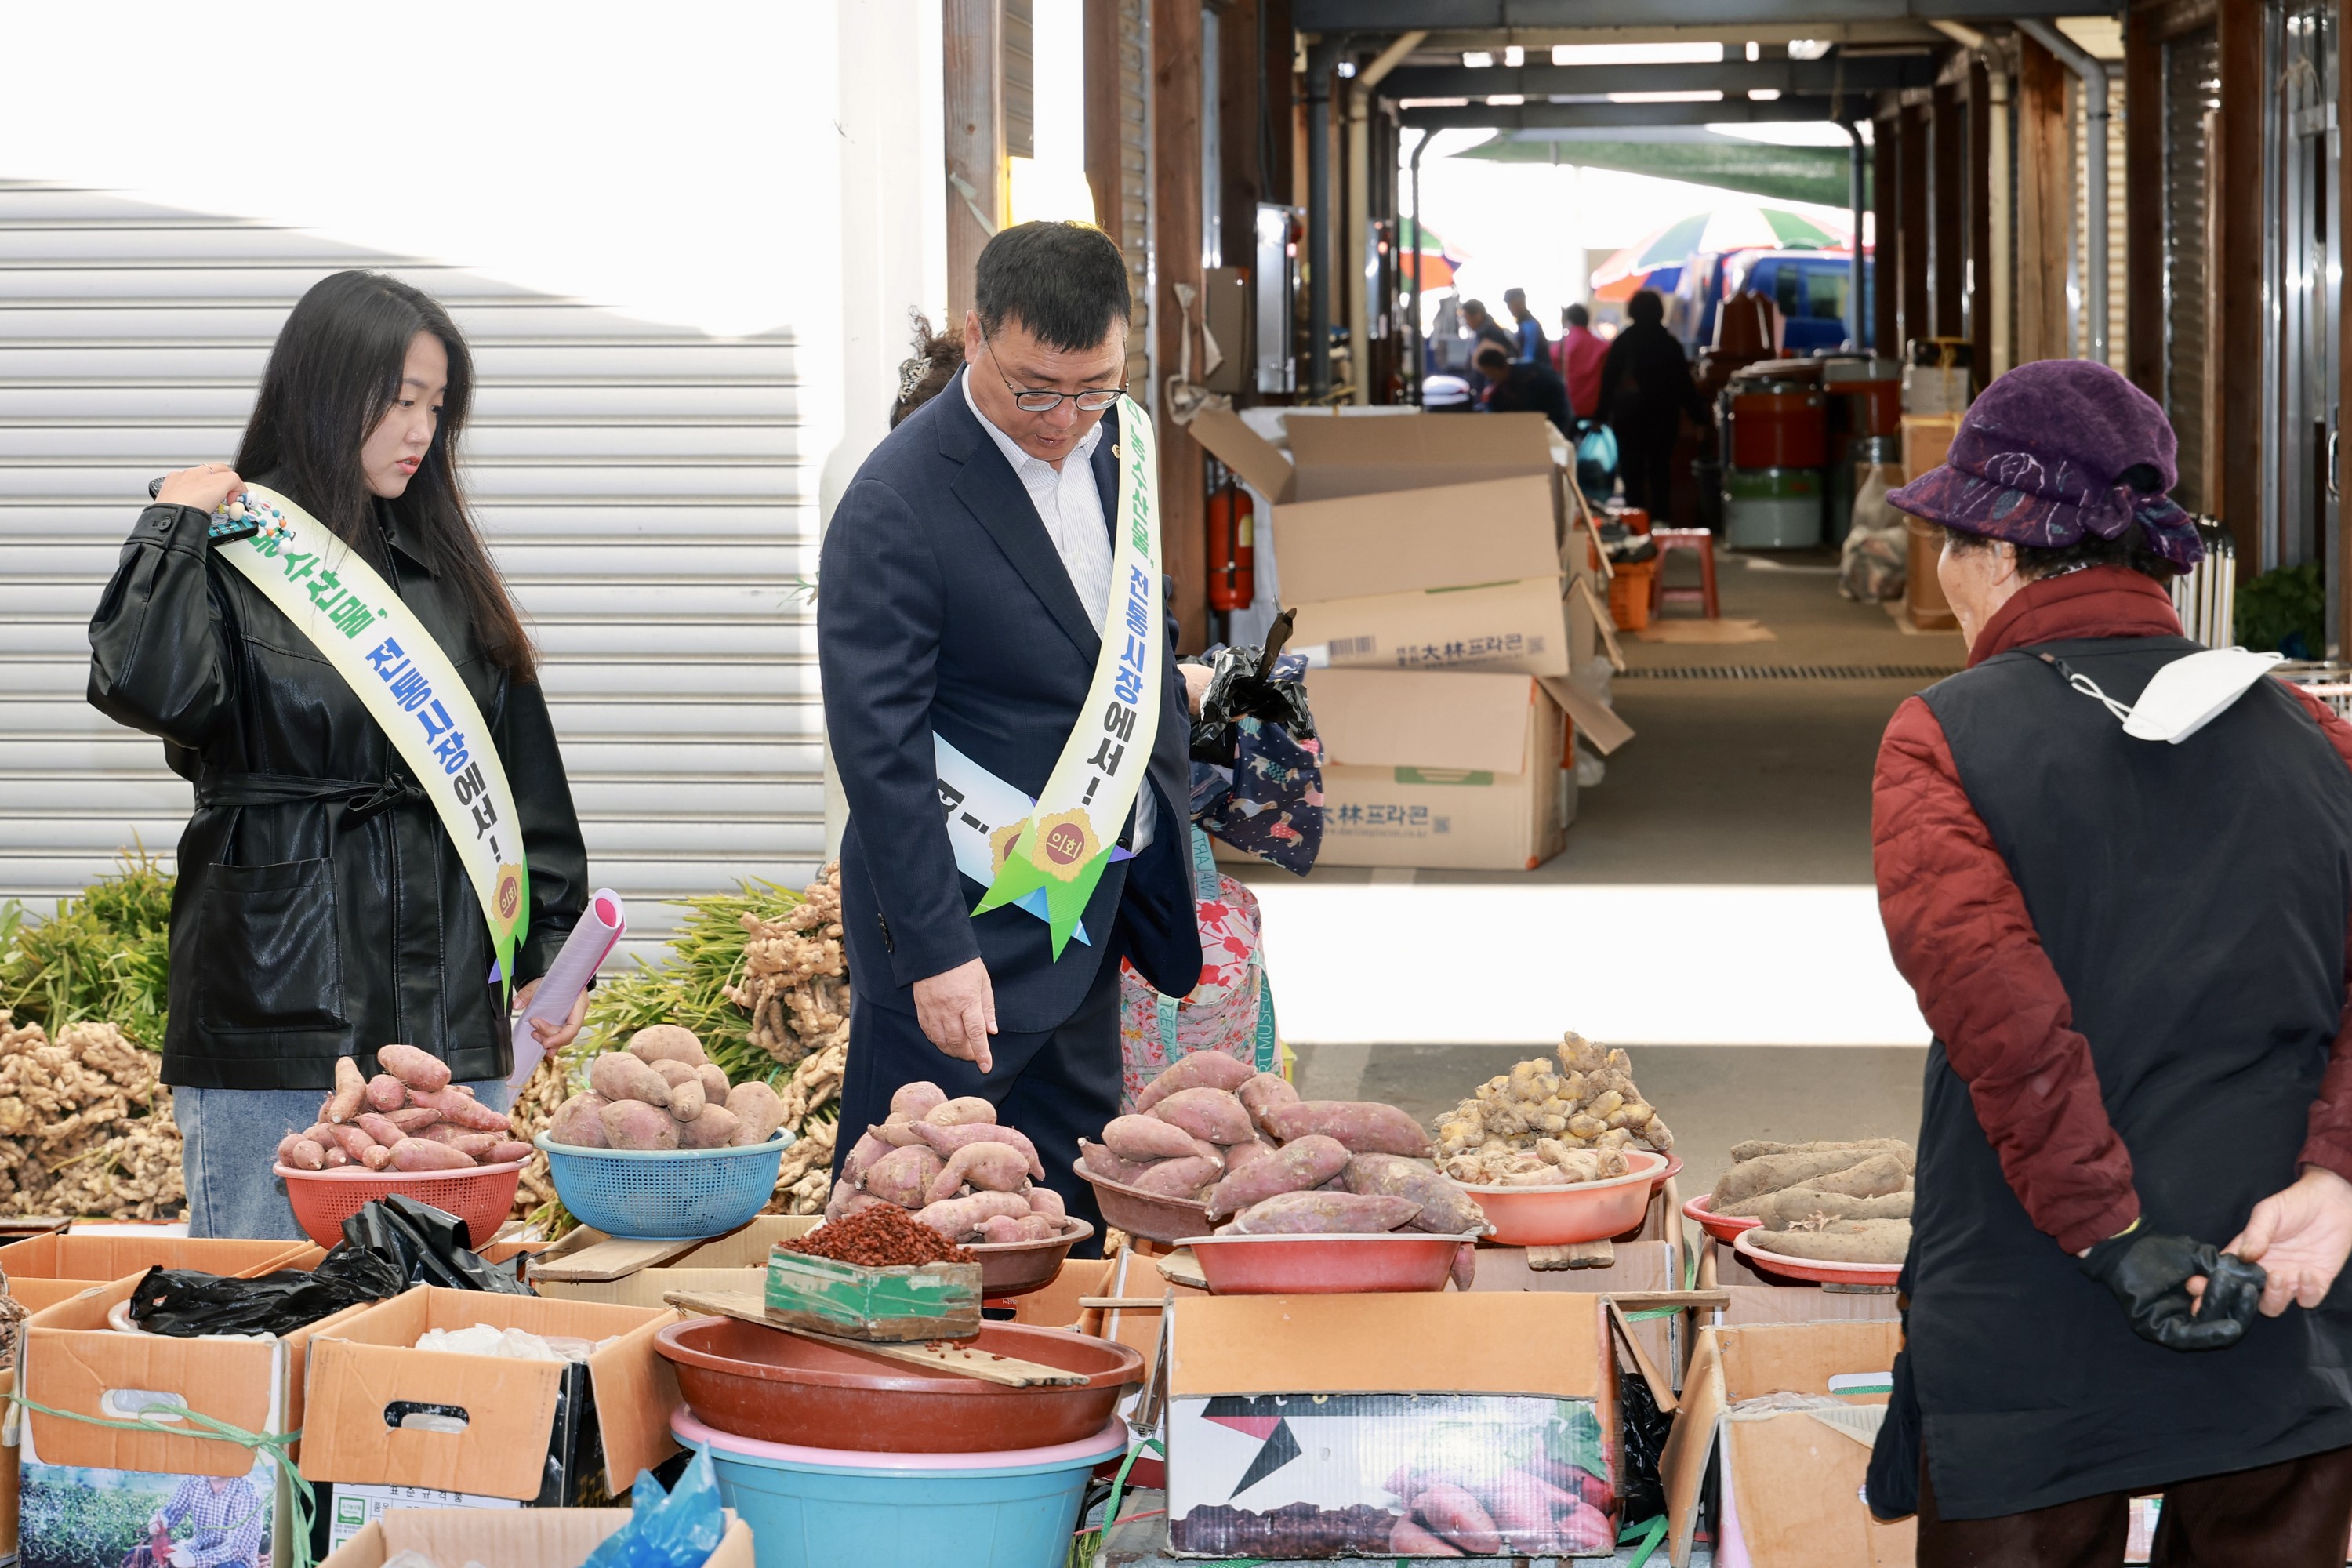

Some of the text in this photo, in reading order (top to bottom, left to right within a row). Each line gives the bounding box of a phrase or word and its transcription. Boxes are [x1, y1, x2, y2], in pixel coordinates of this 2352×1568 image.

[1130, 422, 1154, 569] 농수산물,
[1081, 564, 1149, 806] 전통시장에서!
[365, 637, 502, 863] 전통시장에서!
[1047, 833, 1083, 859] 의회
[501, 880, 517, 916] 의회
[1257, 1054, 1272, 1073] RT
